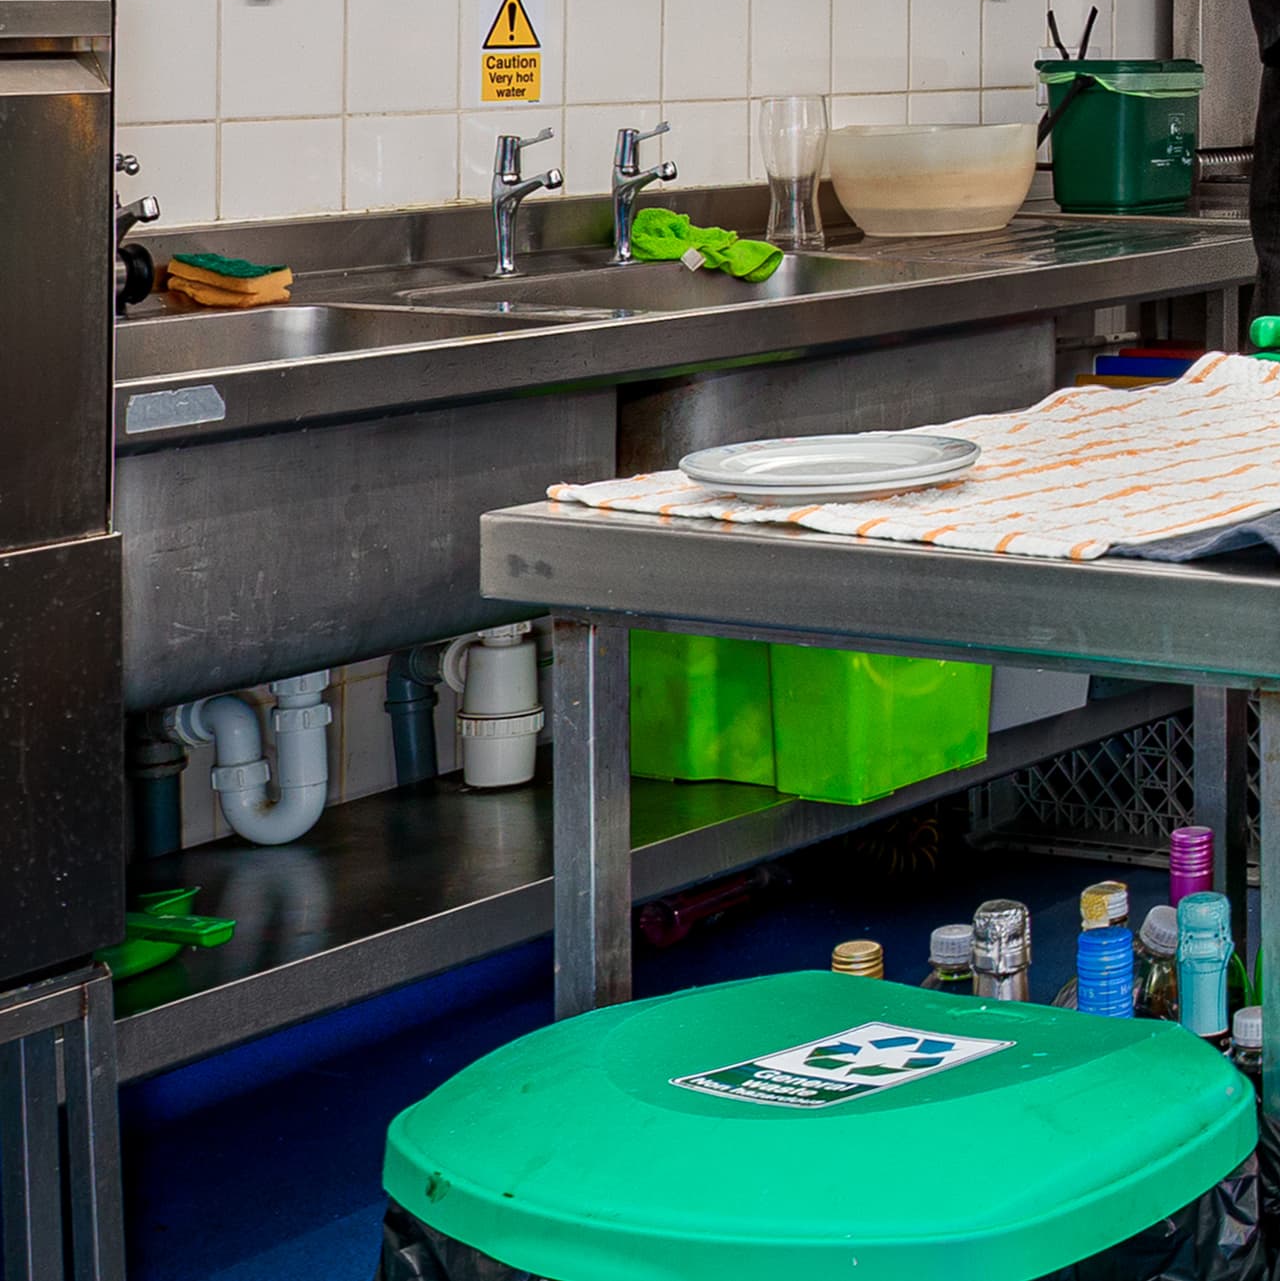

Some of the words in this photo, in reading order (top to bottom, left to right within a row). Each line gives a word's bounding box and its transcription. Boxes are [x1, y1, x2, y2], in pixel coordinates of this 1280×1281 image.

[486, 56, 537, 70] Caution
[489, 72, 513, 86] Very
[516, 71, 534, 83] hot
[496, 87, 526, 97] water
[690, 1077, 731, 1091] Non
[753, 1069, 859, 1092] General
[741, 1079, 819, 1097] Waste
